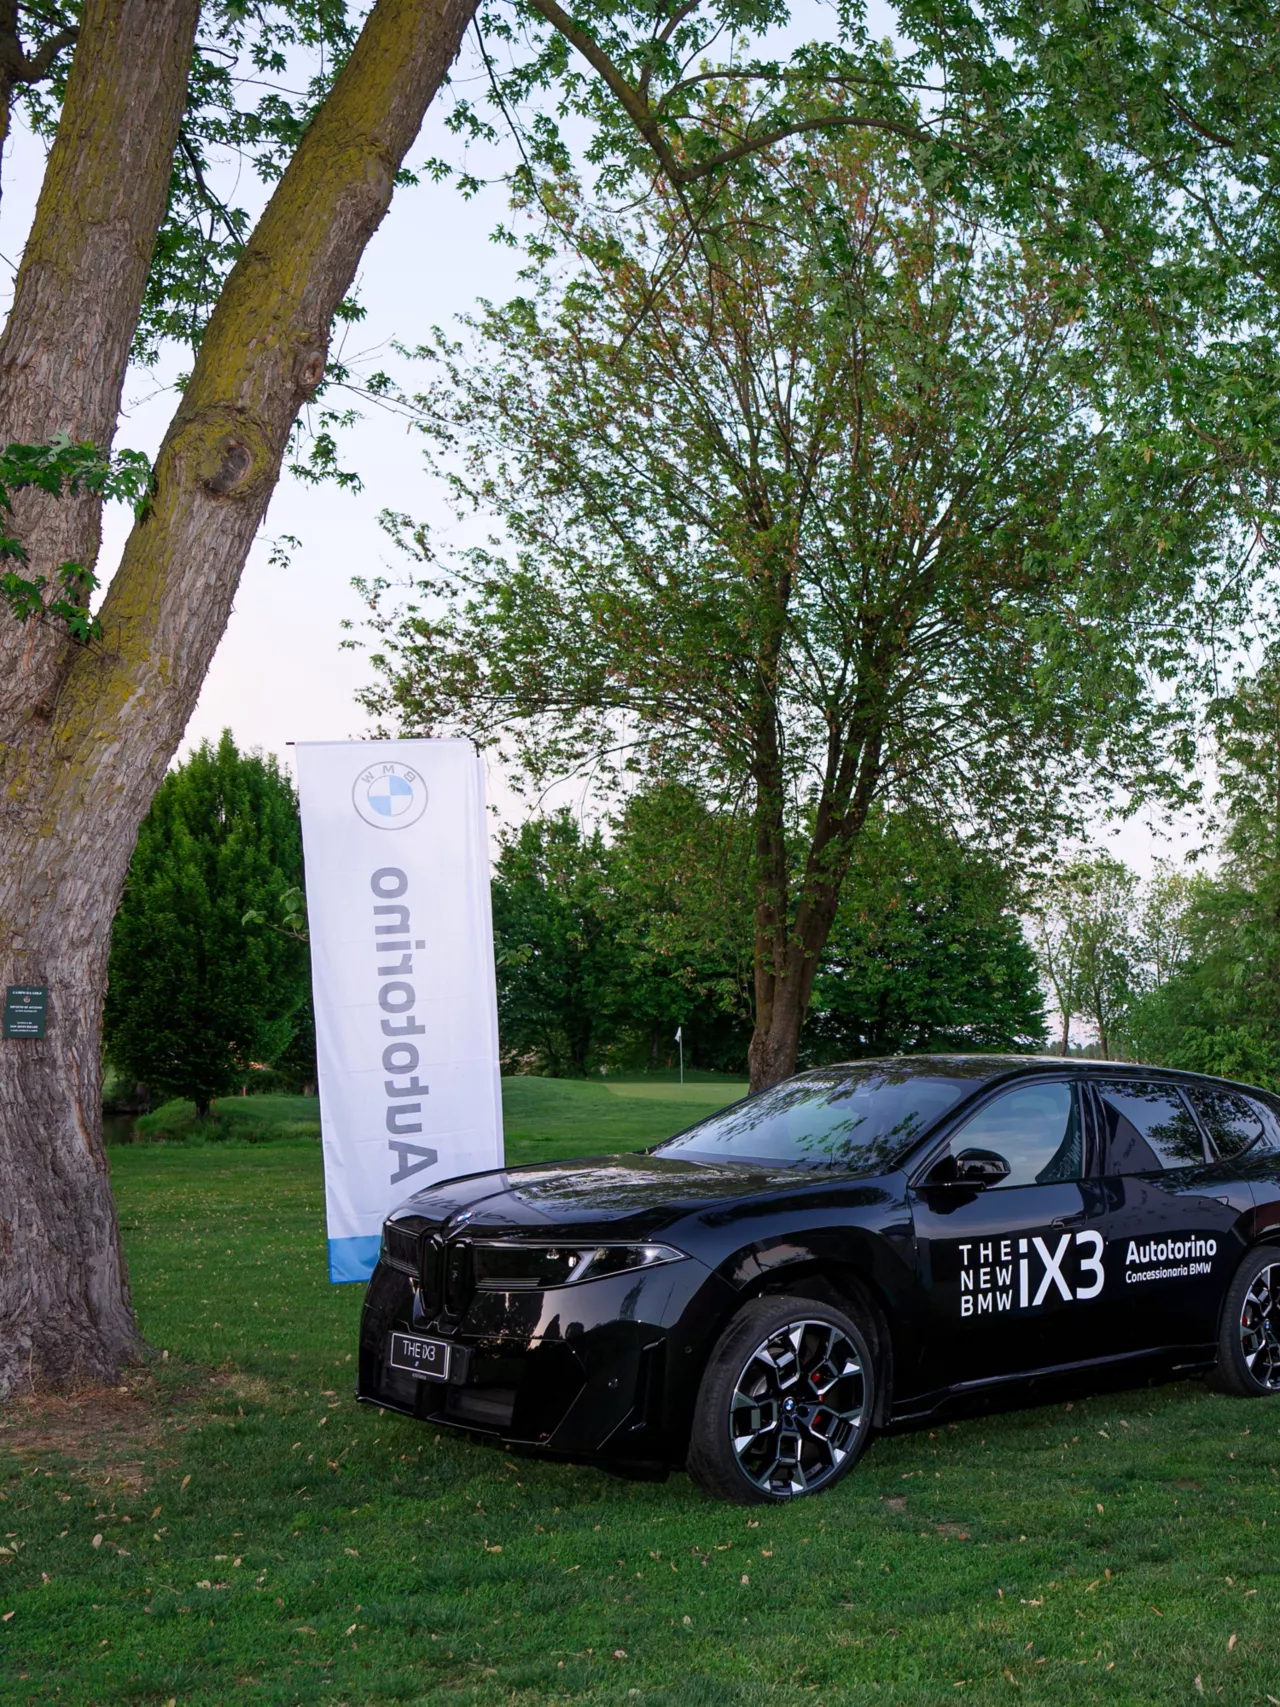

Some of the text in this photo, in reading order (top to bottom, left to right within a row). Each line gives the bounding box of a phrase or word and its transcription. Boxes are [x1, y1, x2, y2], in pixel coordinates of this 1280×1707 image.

[959, 1240, 1012, 1265] THE
[1125, 1235, 1217, 1265] Autotorino
[960, 1265, 1012, 1291] NEW
[1019, 1229, 1106, 1308] iX3
[1125, 1261, 1212, 1284] Concessionaria BMW
[960, 1289, 1013, 1317] BMW
[403, 1340, 436, 1361] THE iX3
